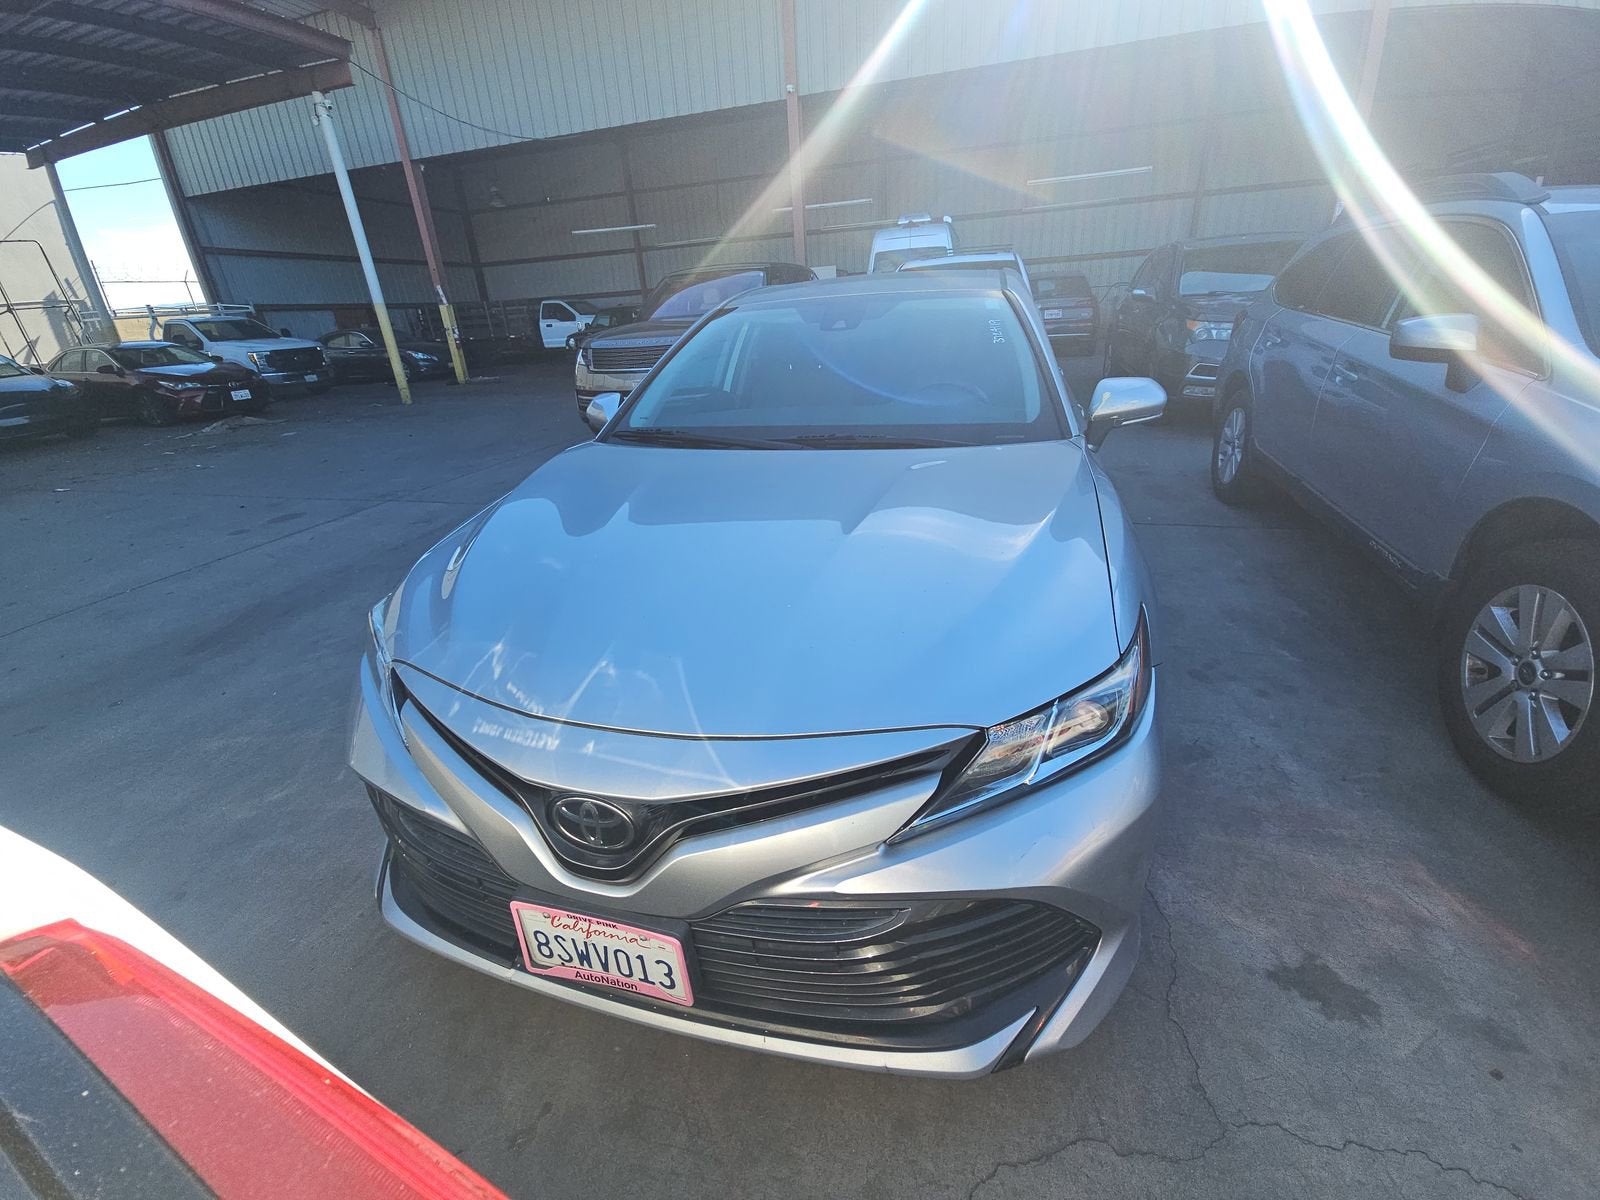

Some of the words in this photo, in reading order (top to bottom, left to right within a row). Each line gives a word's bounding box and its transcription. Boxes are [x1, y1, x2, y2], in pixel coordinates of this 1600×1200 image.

[550, 914, 652, 949] California
[596, 920, 619, 930] PINK
[533, 930, 677, 990] 8SWV013
[575, 970, 638, 991] AutoNation
